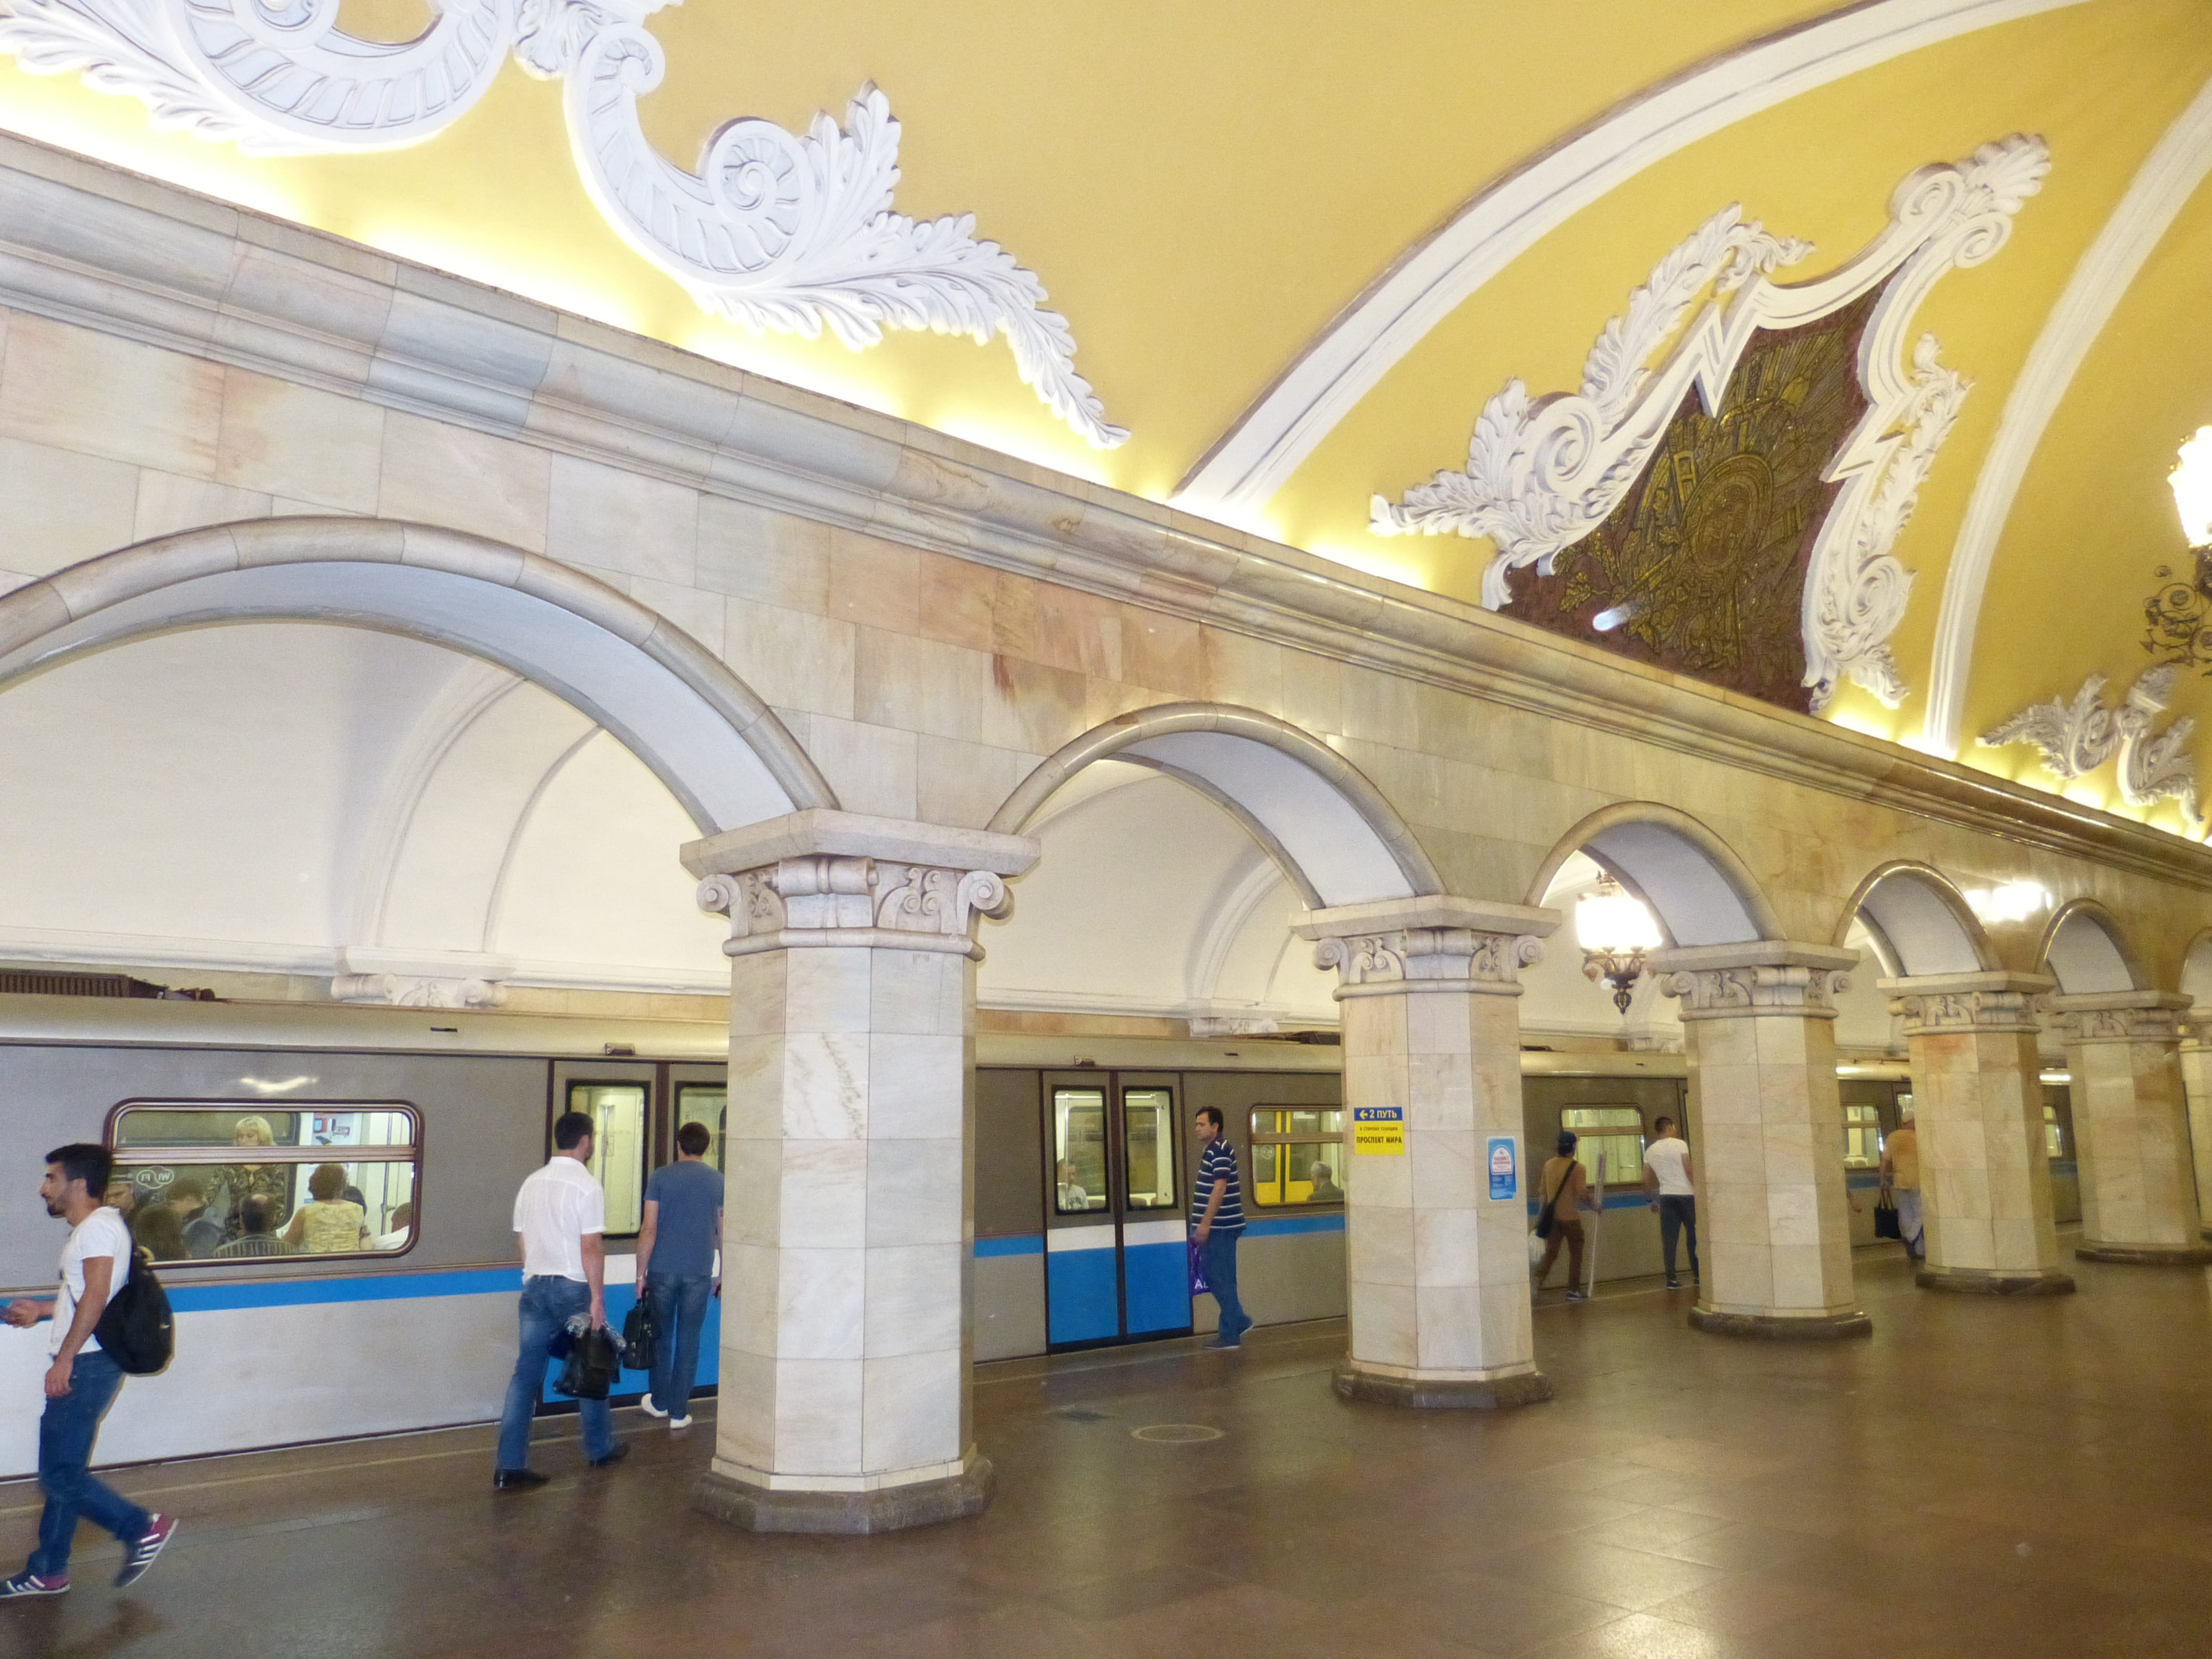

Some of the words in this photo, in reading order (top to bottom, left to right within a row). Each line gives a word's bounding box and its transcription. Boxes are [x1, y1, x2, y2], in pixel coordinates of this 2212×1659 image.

[1369, 1109, 1375, 1119] 2
[1377, 1110, 1397, 1119] ПУТЬ
[1386, 1136, 1402, 1144] МИРА
